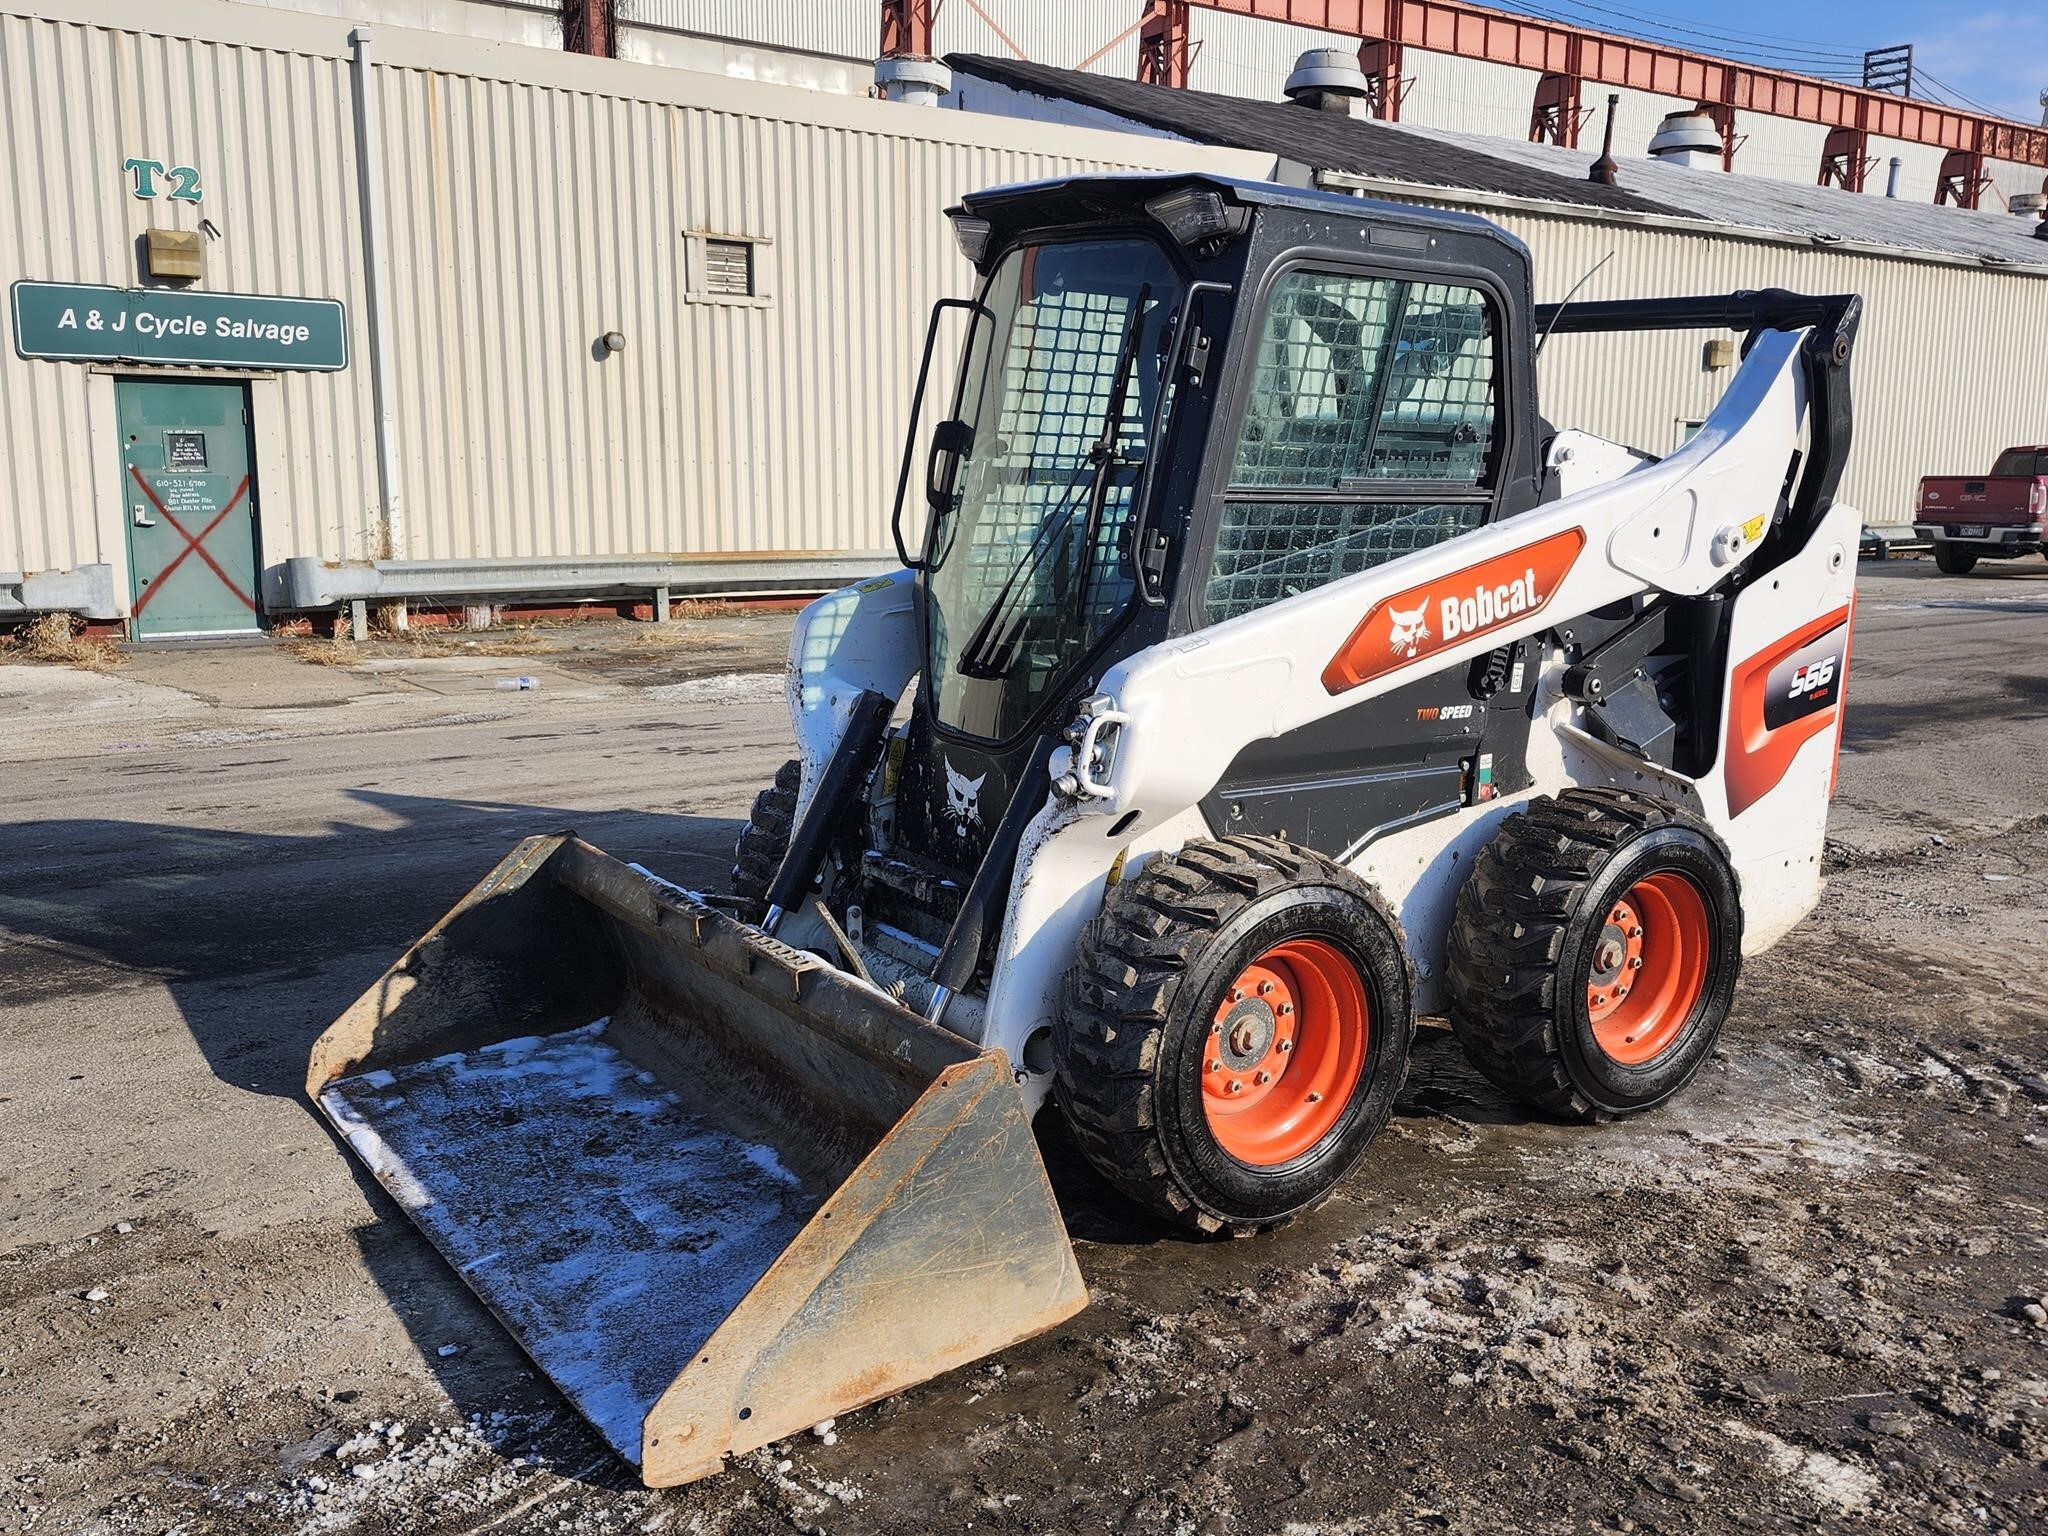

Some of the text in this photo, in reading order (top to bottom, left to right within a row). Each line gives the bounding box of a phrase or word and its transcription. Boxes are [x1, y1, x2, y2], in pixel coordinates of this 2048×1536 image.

[123, 157, 203, 203] T2
[58, 309, 310, 345] A & J Cycle Salvage
[1960, 494, 1987, 502] GMC
[1441, 568, 1536, 641] Bobcat
[1788, 655, 1836, 699] S66
[1417, 705, 1473, 720] TWO SPEED
